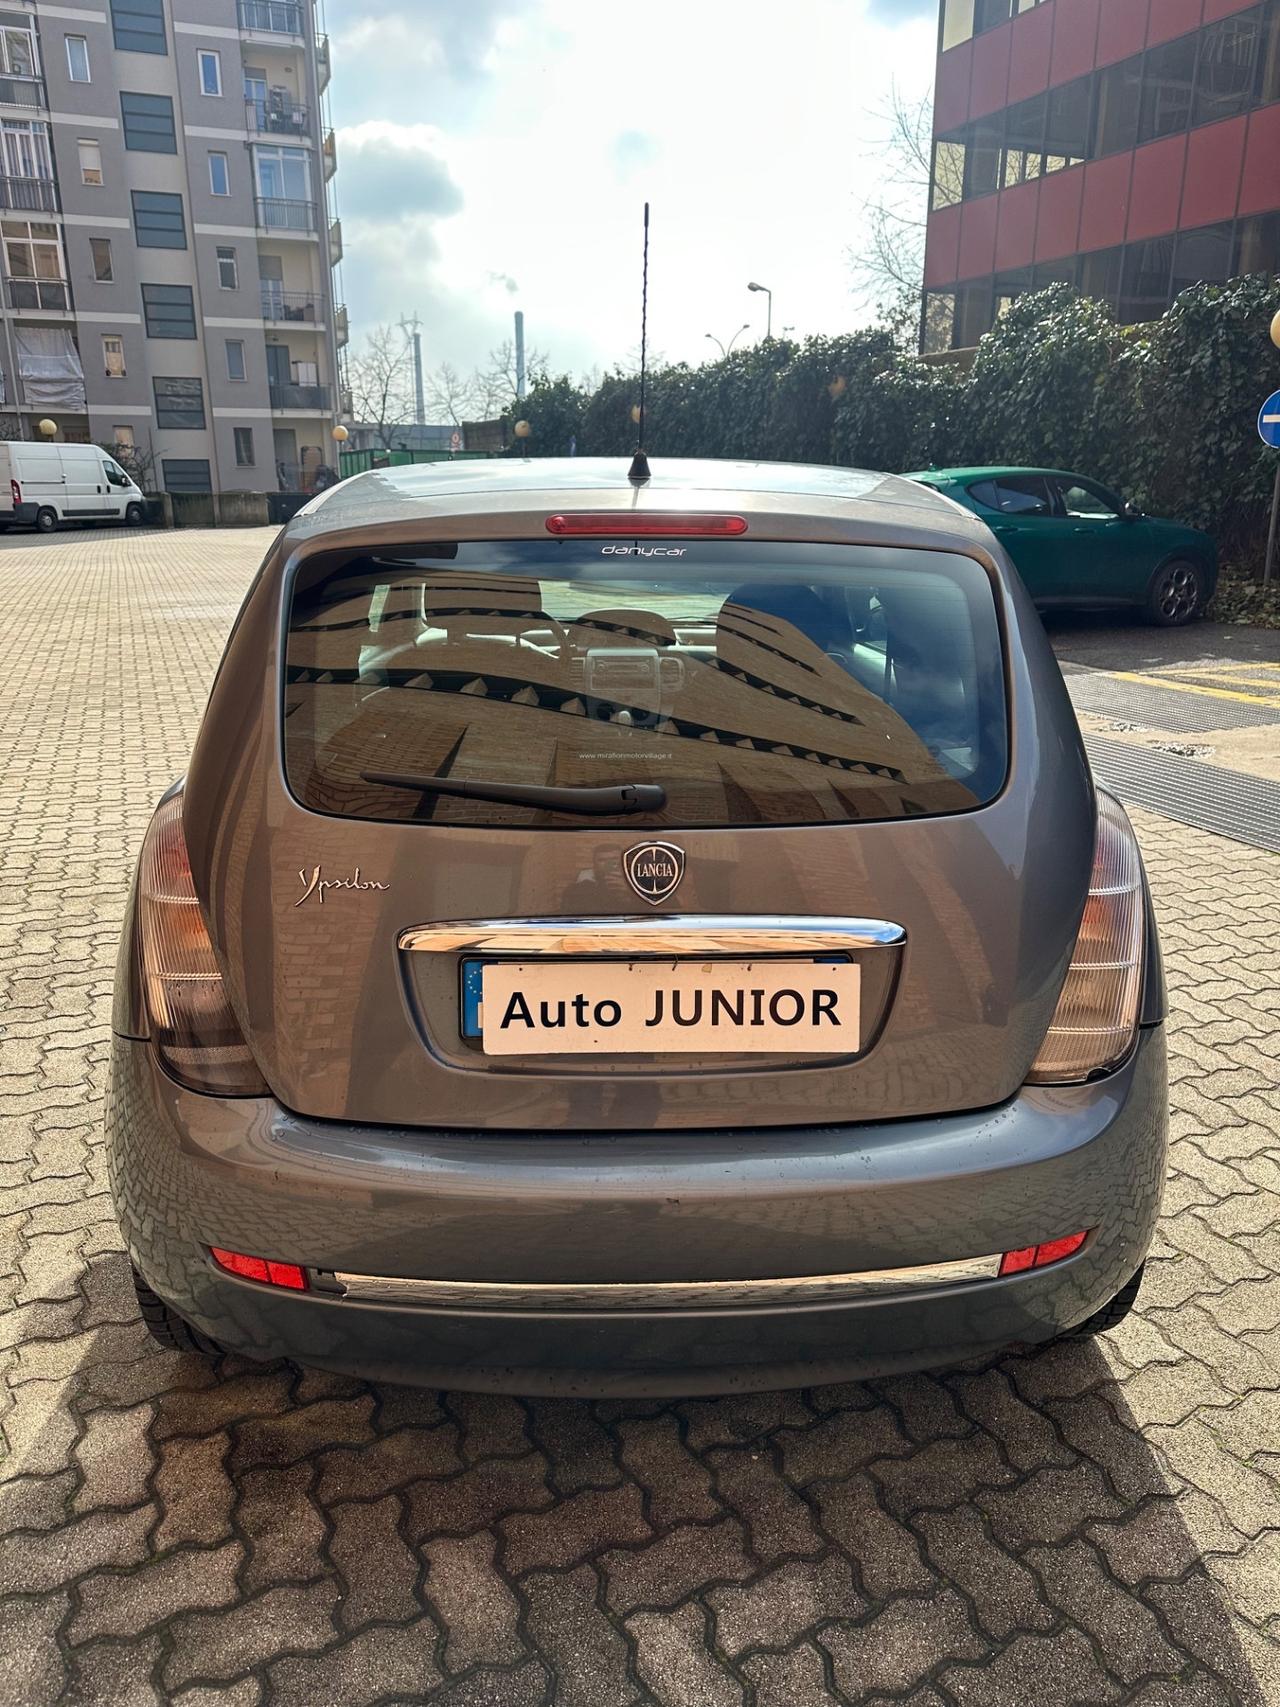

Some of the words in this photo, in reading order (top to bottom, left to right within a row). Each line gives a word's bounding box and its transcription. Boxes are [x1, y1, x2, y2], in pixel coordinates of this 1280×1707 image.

[601, 545, 687, 557] danycar
[637, 862, 673, 877] LANCIA
[294, 864, 390, 908] Ypsilon
[500, 991, 622, 1029] Auto
[645, 989, 841, 1027] JUNIOR
